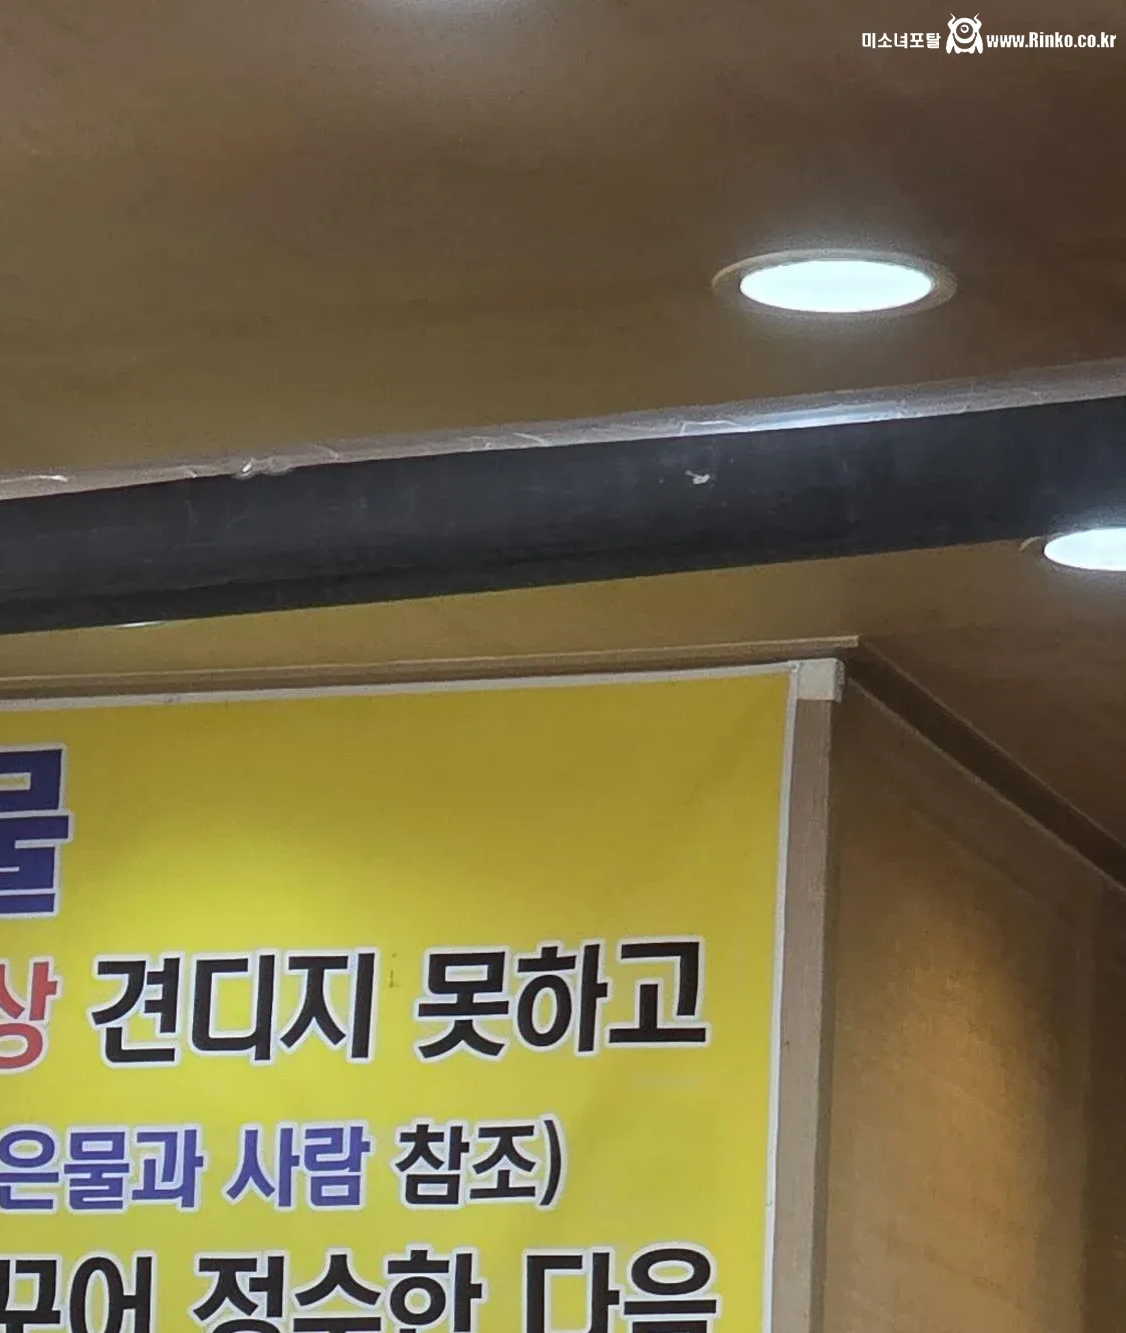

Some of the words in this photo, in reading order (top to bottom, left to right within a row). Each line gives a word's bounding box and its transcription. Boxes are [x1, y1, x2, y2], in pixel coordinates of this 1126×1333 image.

[92, 953, 374, 1062] 견디지
[419, 942, 705, 1057] 못하고
[228, 1127, 369, 1206] 사람
[396, 1120, 561, 1205] 참조)
